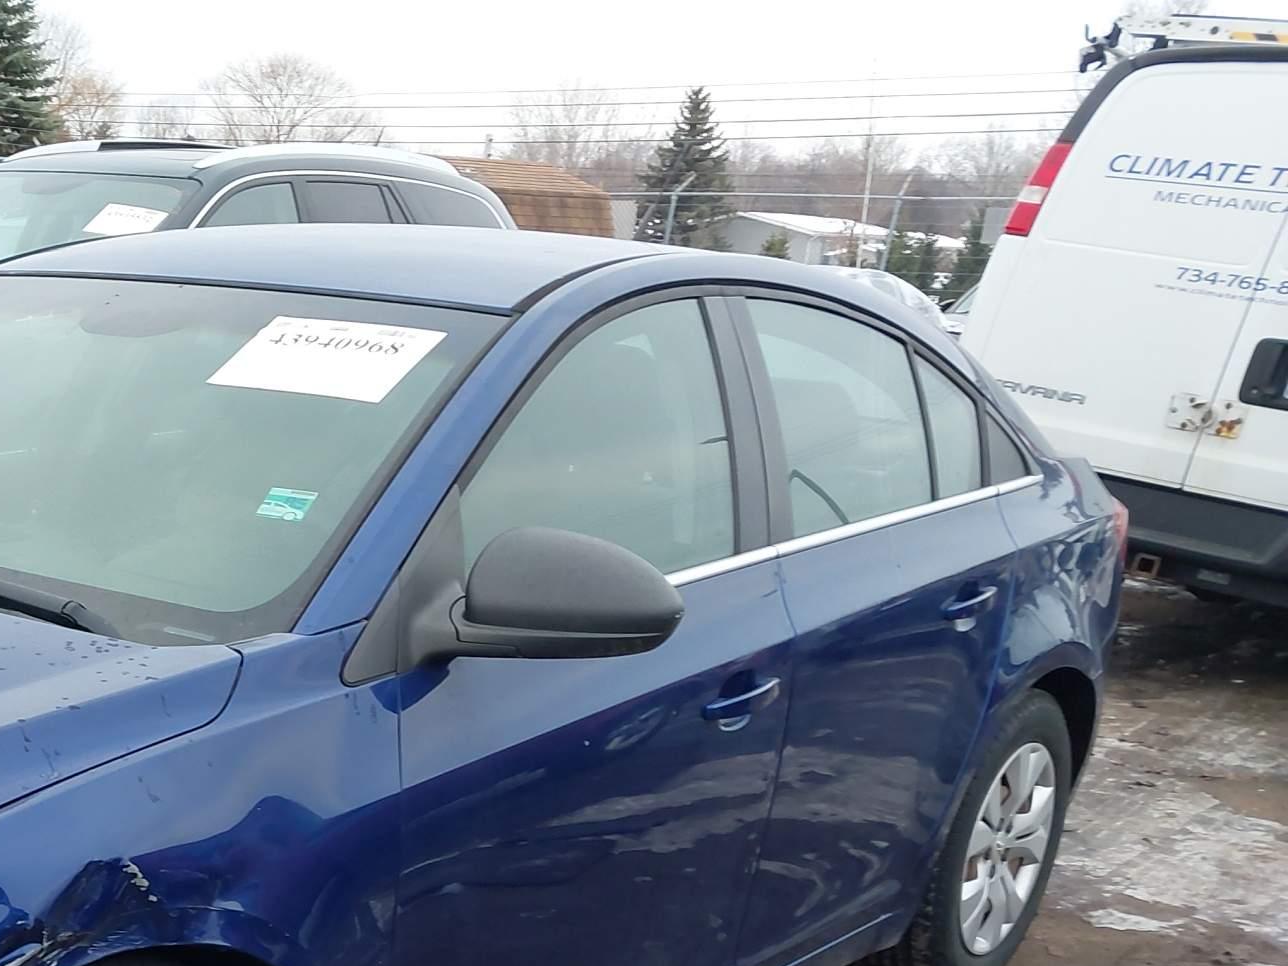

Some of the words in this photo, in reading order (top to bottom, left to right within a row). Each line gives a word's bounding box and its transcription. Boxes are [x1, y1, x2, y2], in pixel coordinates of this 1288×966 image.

[1108, 154, 1262, 184] CLIMATE
[1268, 167, 1288, 187] T
[1176, 266, 1288, 295] 734-765-8
[269, 333, 405, 355] 43940968
[995, 379, 1087, 405] AVANA
